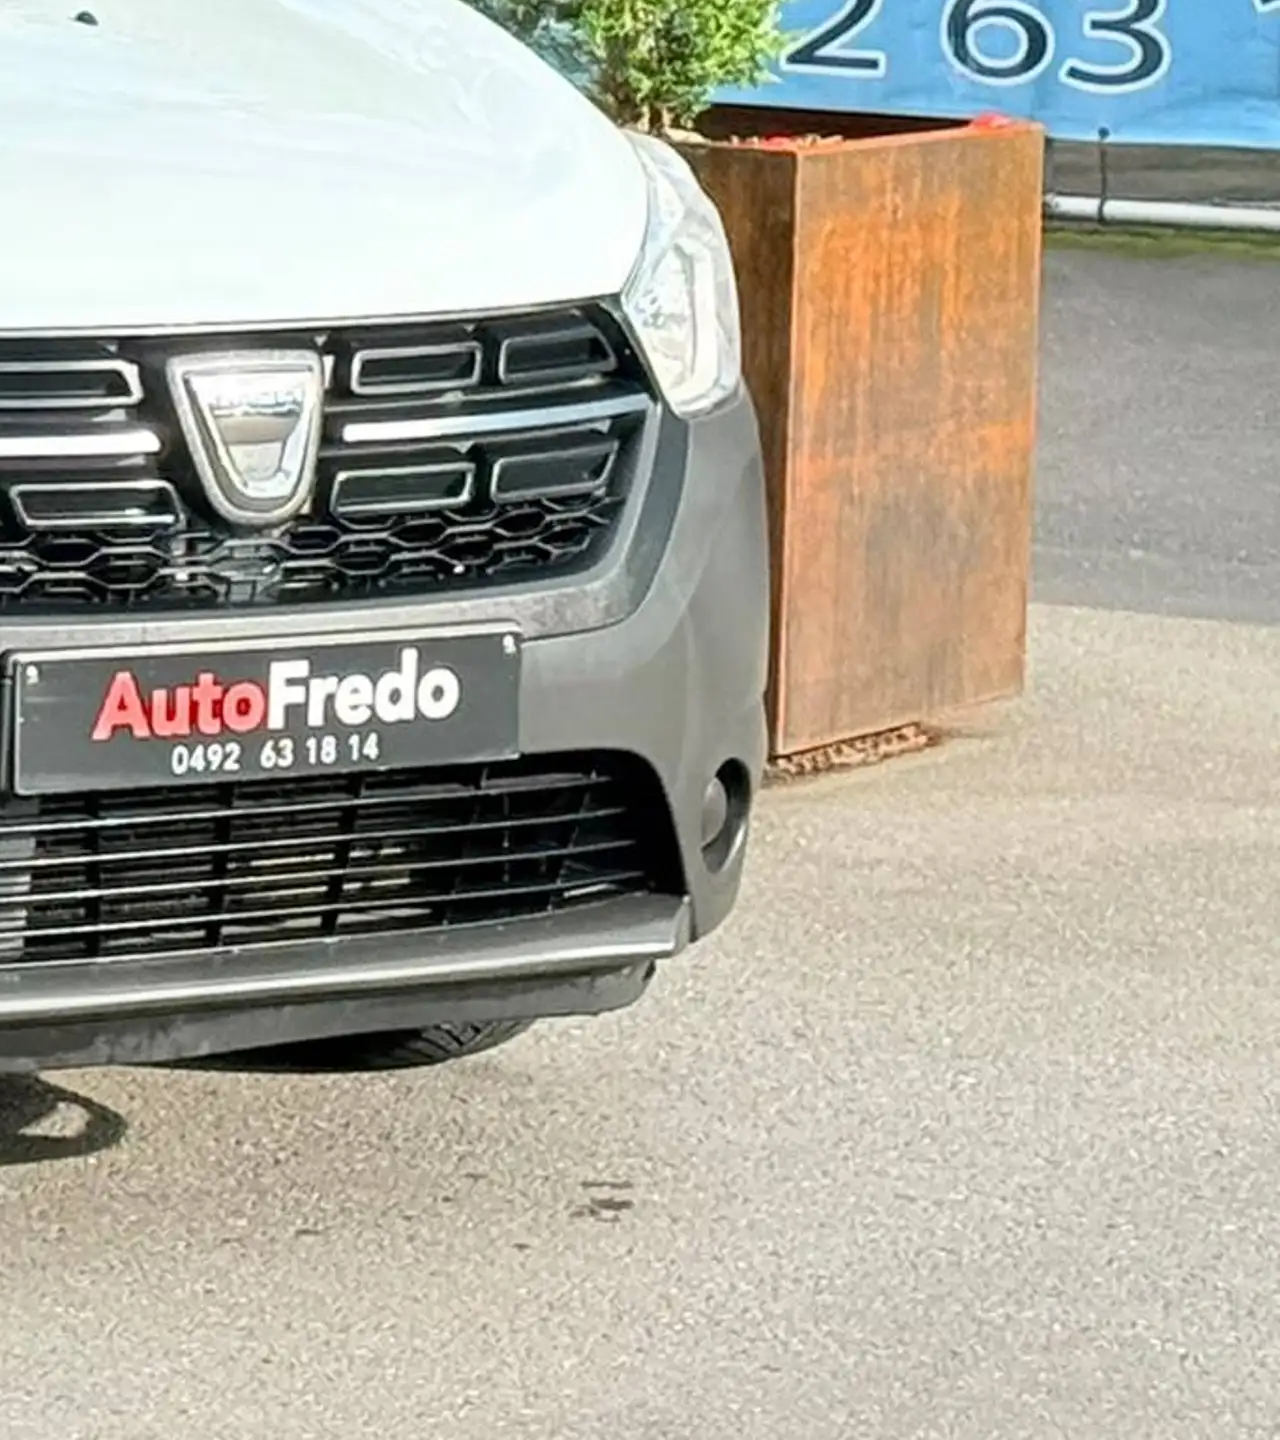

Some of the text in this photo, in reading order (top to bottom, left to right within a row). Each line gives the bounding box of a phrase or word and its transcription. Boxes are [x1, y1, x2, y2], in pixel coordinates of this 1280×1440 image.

[90, 646, 462, 742] AutoFredo
[171, 731, 381, 775] 0492 63 18 14
